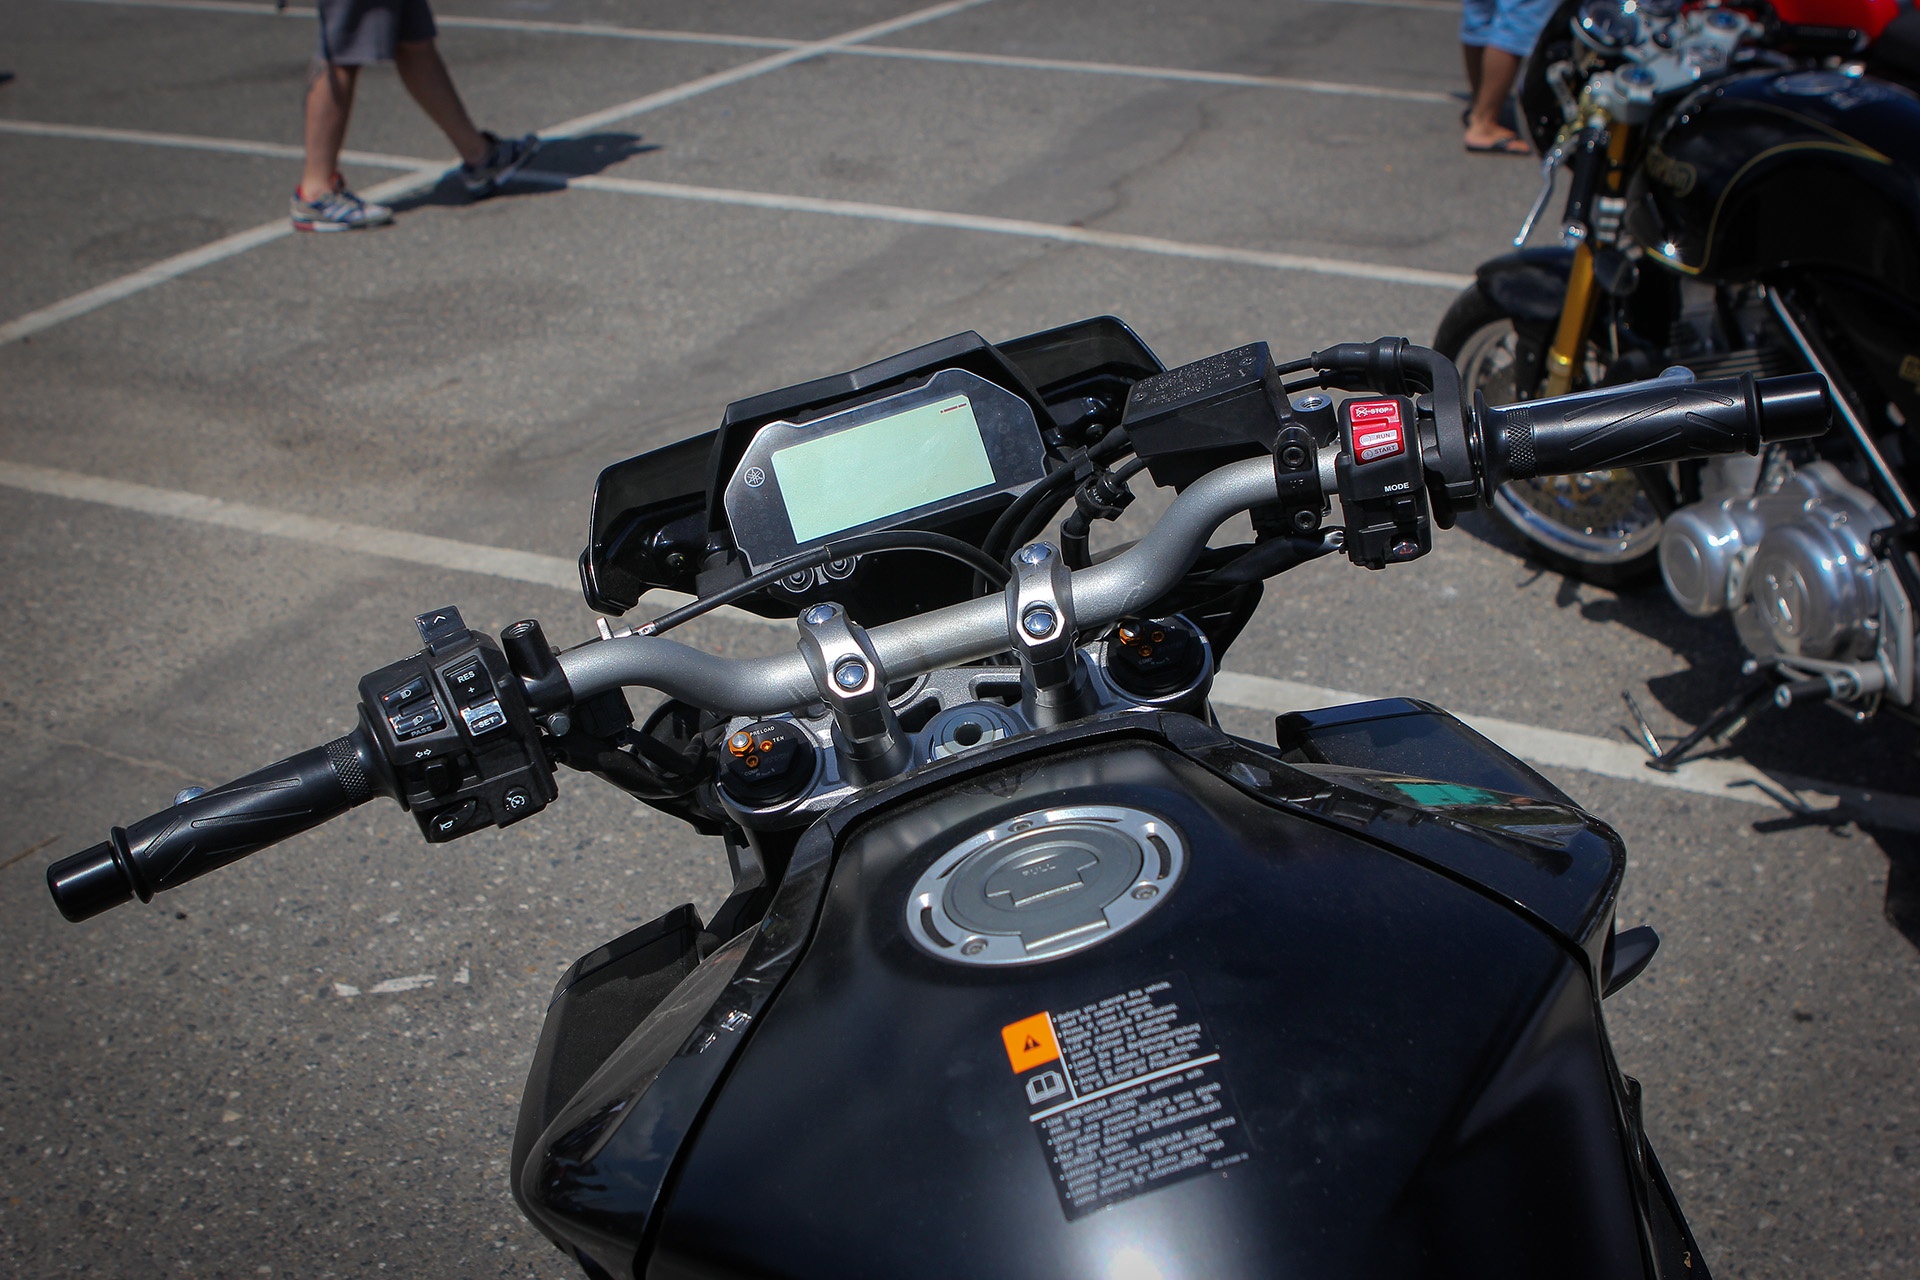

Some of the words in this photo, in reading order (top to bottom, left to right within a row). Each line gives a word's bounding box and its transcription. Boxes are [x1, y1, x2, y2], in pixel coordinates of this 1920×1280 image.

[1371, 407, 1389, 415] STOP
[1376, 432, 1391, 440] RUN
[1374, 445, 1396, 455] START
[1384, 482, 1410, 492] MODE
[457, 670, 475, 683] RES
[479, 716, 495, 728] SET
[411, 726, 433, 737] PASS
[750, 725, 776, 737] PRELOAD
[1082, 1003, 1097, 1014] you
[1064, 1098, 1107, 1120] PREMIUM
[1109, 1086, 1147, 1104] unleaded
[1148, 1074, 1184, 1093] gasoline
[1185, 1068, 1204, 1080] with
[1138, 1096, 1170, 1114] SUPER
[1138, 1130, 1183, 1152] PREMIUM
